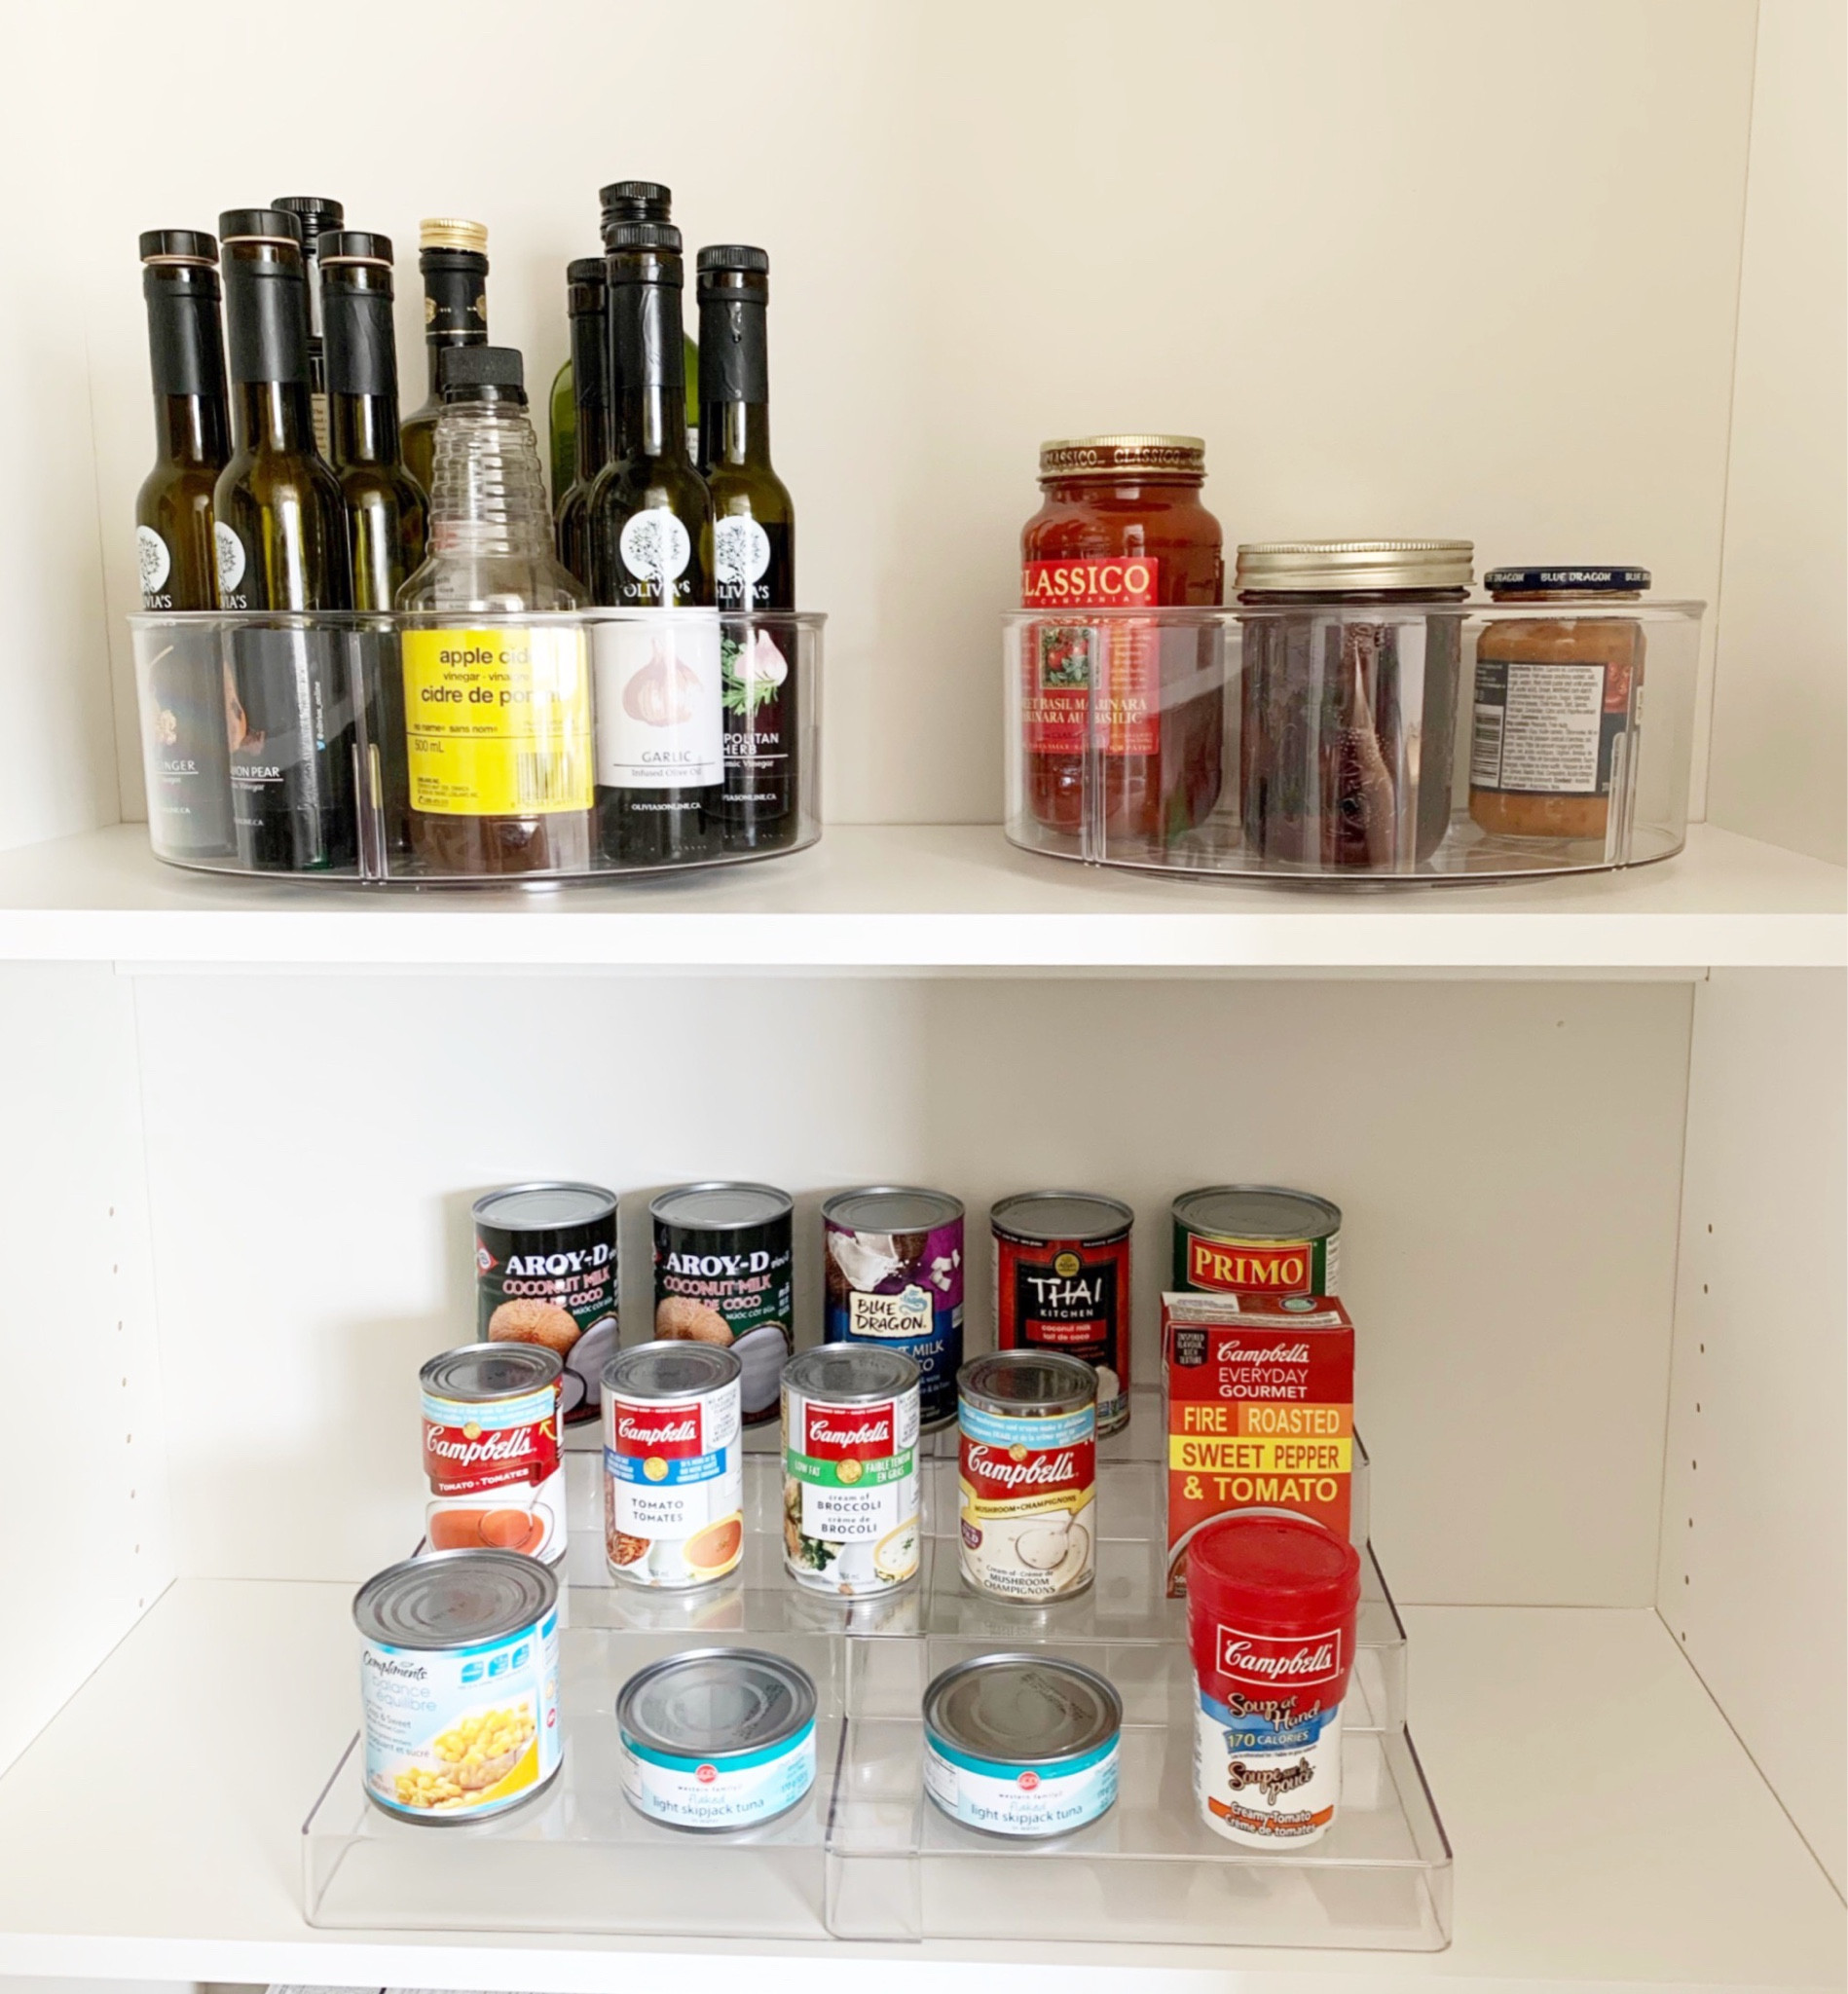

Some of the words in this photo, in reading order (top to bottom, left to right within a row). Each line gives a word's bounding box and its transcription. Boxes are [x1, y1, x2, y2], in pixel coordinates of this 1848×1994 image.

[1022, 565, 1150, 597] LASSICO
[1540, 572, 1567, 582] BLUE
[1569, 572, 1611, 582] DRAGON
[623, 580, 690, 598] OLIVA'S
[440, 647, 493, 667] apple
[443, 672, 480, 683] vinegar
[421, 686, 462, 703] cidre
[468, 686, 494, 703] de
[1040, 698, 1073, 710] BASIL
[415, 740, 428, 752] 500
[430, 741, 444, 753] mL
[642, 751, 691, 762] GARLIC
[251, 767, 279, 777] PEAR
[505, 1243, 609, 1276] AROY-D
[666, 1251, 770, 1276] AROY-D
[1195, 1246, 1303, 1285] PRIMO
[503, 1275, 581, 1296] COCONUT
[583, 1266, 610, 1289] MILK
[664, 1276, 735, 1296] COCONUT
[739, 1274, 772, 1294] MILK
[570, 1287, 604, 1307] COCO
[1027, 1277, 1101, 1308] THAI
[722, 1295, 761, 1311] COCO
[857, 1299, 897, 1315] BLUE
[855, 1314, 924, 1333] DRAGON
[1040, 1309, 1093, 1318] KITCHEN
[912, 1340, 944, 1357] MILK
[1217, 1340, 1310, 1366] Campbell's
[1219, 1367, 1309, 1384] EVERYDAY
[1219, 1385, 1308, 1398] GOURMET
[1184, 1407, 1227, 1431] FIRE
[1248, 1408, 1340, 1434] ROASTED
[618, 1417, 697, 1447] Campbell's
[809, 1420, 889, 1448] Campbell's
[426, 1424, 533, 1466] Campbell's
[866, 1457, 890, 1473] FAIBLE
[1182, 1443, 1265, 1468] SWEET
[1275, 1445, 1340, 1469] PEPPER
[795, 1460, 807, 1473] LOW
[808, 1463, 821, 1477] FAT
[877, 1470, 887, 1483] EN
[888, 1465, 905, 1481] GRAS
[968, 1444, 1075, 1489] Campbell's
[439, 1480, 474, 1492] TOMATO
[480, 1468, 530, 1486] TOMATES
[1183, 1475, 1203, 1500] &
[1213, 1477, 1338, 1502] TOMATO
[631, 1498, 684, 1510] TOMATO
[817, 1500, 881, 1512] BROCCOLI
[1020, 1495, 1077, 1510] CHAMPIGNONS
[634, 1511, 683, 1522] TOMATES
[821, 1524, 877, 1534] BROCOLI
[984, 1579, 1056, 1595] CHAMPIGNONS
[989, 1573, 1050, 1585] MUSHROOM
[363, 1650, 427, 1680] Compliments
[1224, 1640, 1333, 1680] Campbell's
[372, 1676, 430, 1698] balance
[1227, 1692, 1278, 1720] Soup
[1280, 1695, 1298, 1709] at
[1272, 1699, 1321, 1732] Hand
[1228, 1733, 1256, 1748] 170
[1257, 1730, 1310, 1745] CALORIES
[1228, 1761, 1282, 1794] Soupe
[1268, 1772, 1313, 1806] pouce
[653, 1796, 683, 1813] light
[682, 1801, 735, 1819] skipjack
[737, 1799, 764, 1813] tuna
[971, 1804, 999, 1821] light
[1002, 1809, 1053, 1826] skipjack
[1056, 1804, 1083, 1820] tuna
[1231, 1801, 1270, 1827] Creamy
[1272, 1810, 1312, 1825] Tomato
[1225, 1814, 1256, 1833] Crème
[1258, 1823, 1273, 1836] de
[1275, 1824, 1316, 1837] tomates
